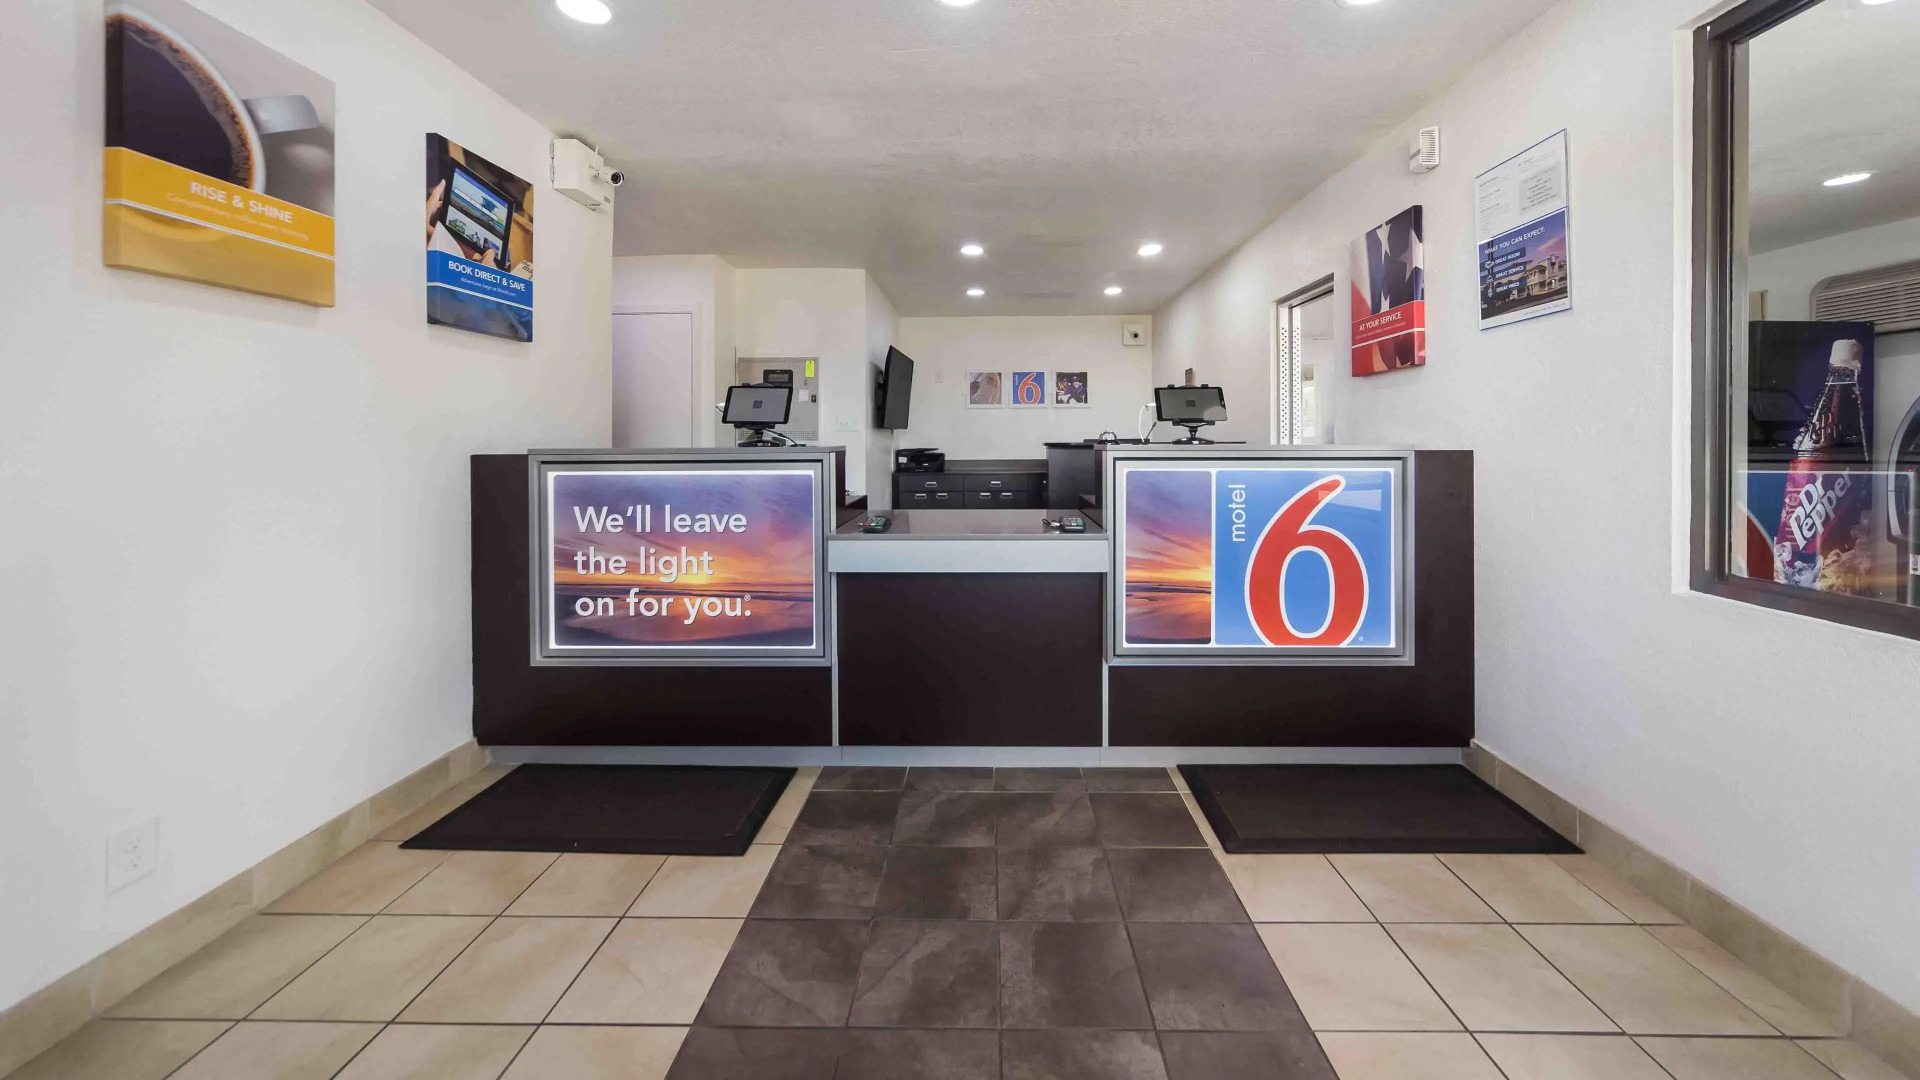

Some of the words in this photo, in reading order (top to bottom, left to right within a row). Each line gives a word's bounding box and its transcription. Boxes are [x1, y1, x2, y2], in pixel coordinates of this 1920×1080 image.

[190, 182, 228, 204] RISE
[231, 195, 244, 208] &
[248, 200, 293, 224] SHINE
[1485, 244, 1499, 255] WHAT
[1500, 240, 1510, 249] YOU
[1511, 235, 1523, 245] CAN
[448, 260, 473, 276] BOOK
[474, 268, 502, 284] DIRECT
[502, 277, 508, 287] &
[509, 280, 526, 292] SAVE
[1359, 323, 1366, 332] AT
[1366, 318, 1380, 329] YOUR
[1379, 311, 1402, 325] SERVICE
[1018, 372, 1041, 405] 6
[1789, 466, 1851, 551] Pepper
[1799, 475, 1825, 517] Dr
[573, 504, 652, 534] We'll
[664, 504, 749, 534] leave
[573, 546, 628, 576] the
[639, 546, 715, 583] light
[1228, 483, 1246, 543] motel
[1244, 474, 1370, 647] 6
[574, 596, 615, 617] on
[626, 587, 674, 617] for
